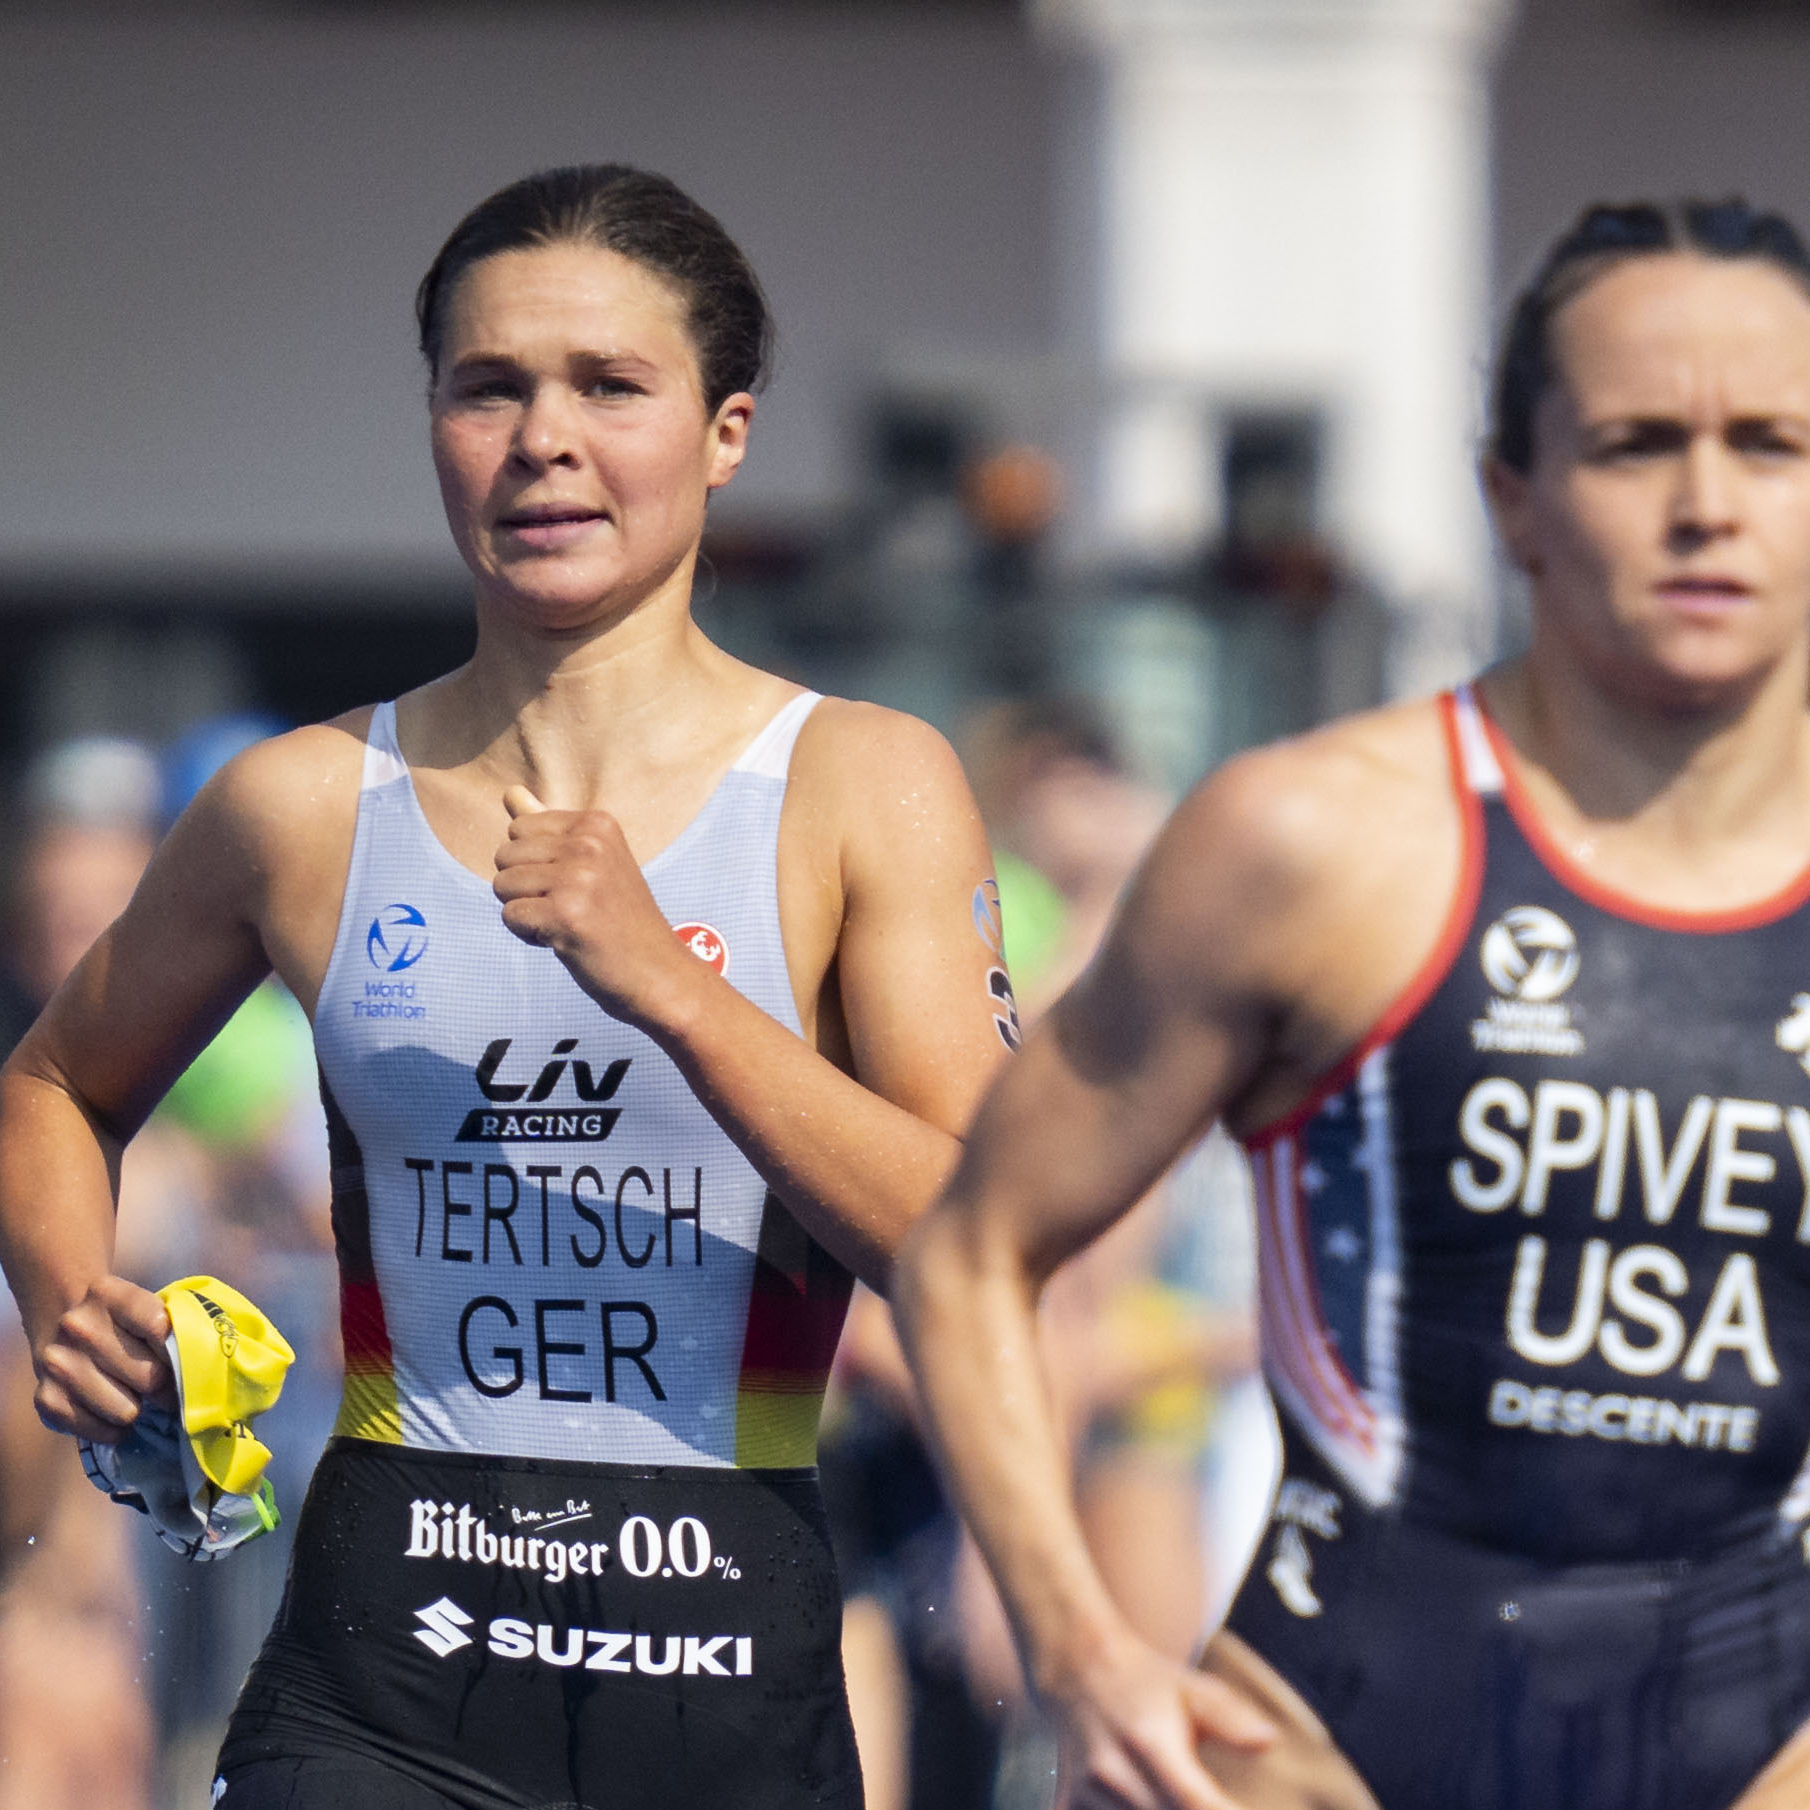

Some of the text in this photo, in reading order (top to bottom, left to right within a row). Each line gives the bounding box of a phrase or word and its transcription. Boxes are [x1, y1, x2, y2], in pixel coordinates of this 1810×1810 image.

[351, 1000, 427, 1019] Triathlon
[364, 978, 416, 999] World
[480, 1111, 603, 1140] RACING
[403, 1156, 703, 1269] TERTSCH
[1505, 1234, 1781, 1387] USA
[456, 1295, 669, 1402] GER
[1488, 1380, 1760, 1452] DESCENTE
[403, 1499, 610, 1583] Bitburger
[487, 1616, 754, 1677] SUZUKI
